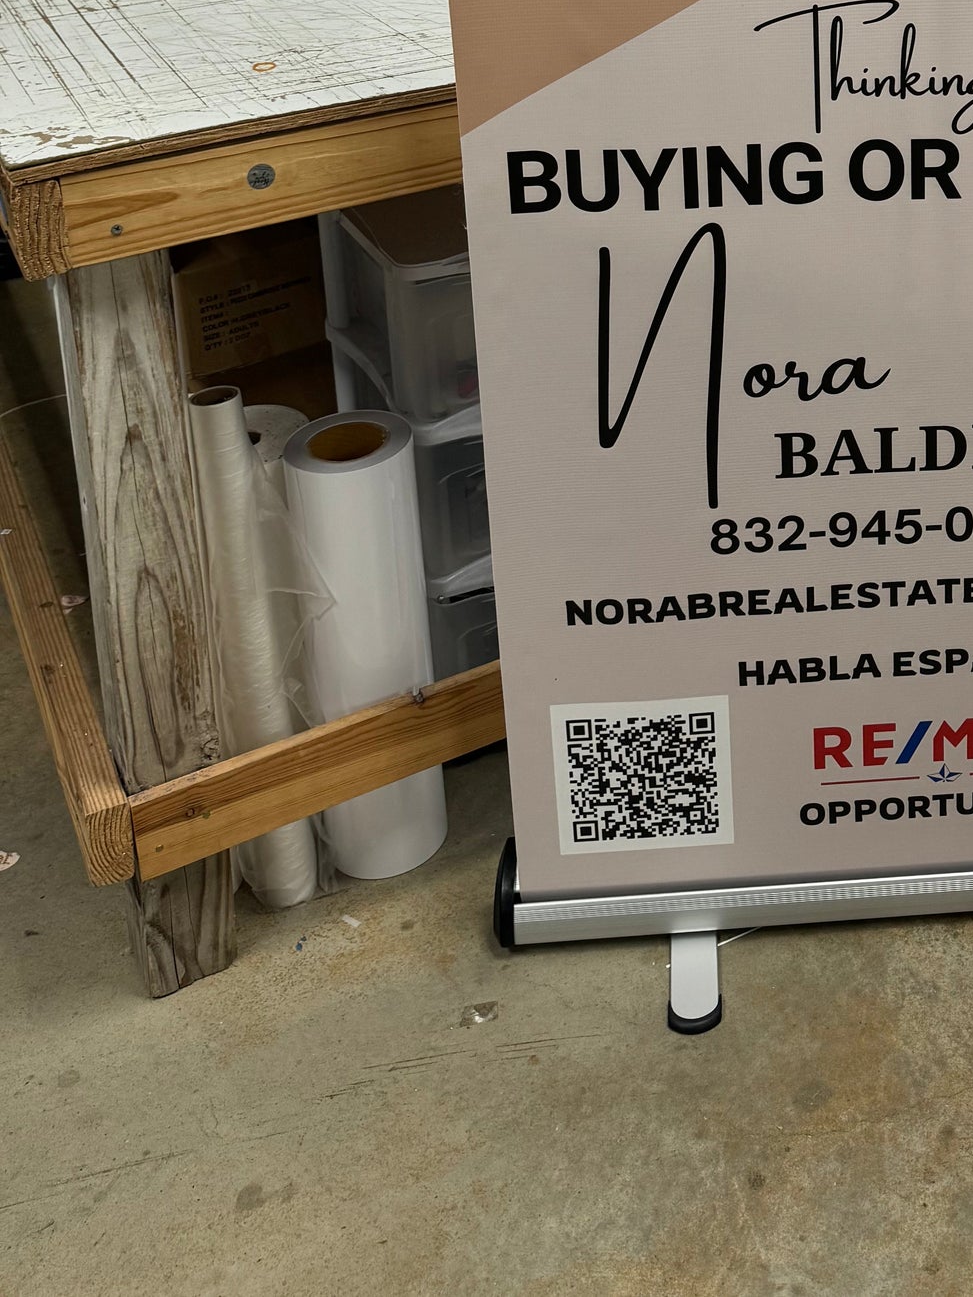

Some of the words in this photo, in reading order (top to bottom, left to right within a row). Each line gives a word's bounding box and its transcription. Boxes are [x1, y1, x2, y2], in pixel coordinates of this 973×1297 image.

[506, 141, 824, 215] BUYING
[848, 138, 962, 202] OR
[597, 222, 892, 510] Nora
[738, 653, 881, 687] HABLA
